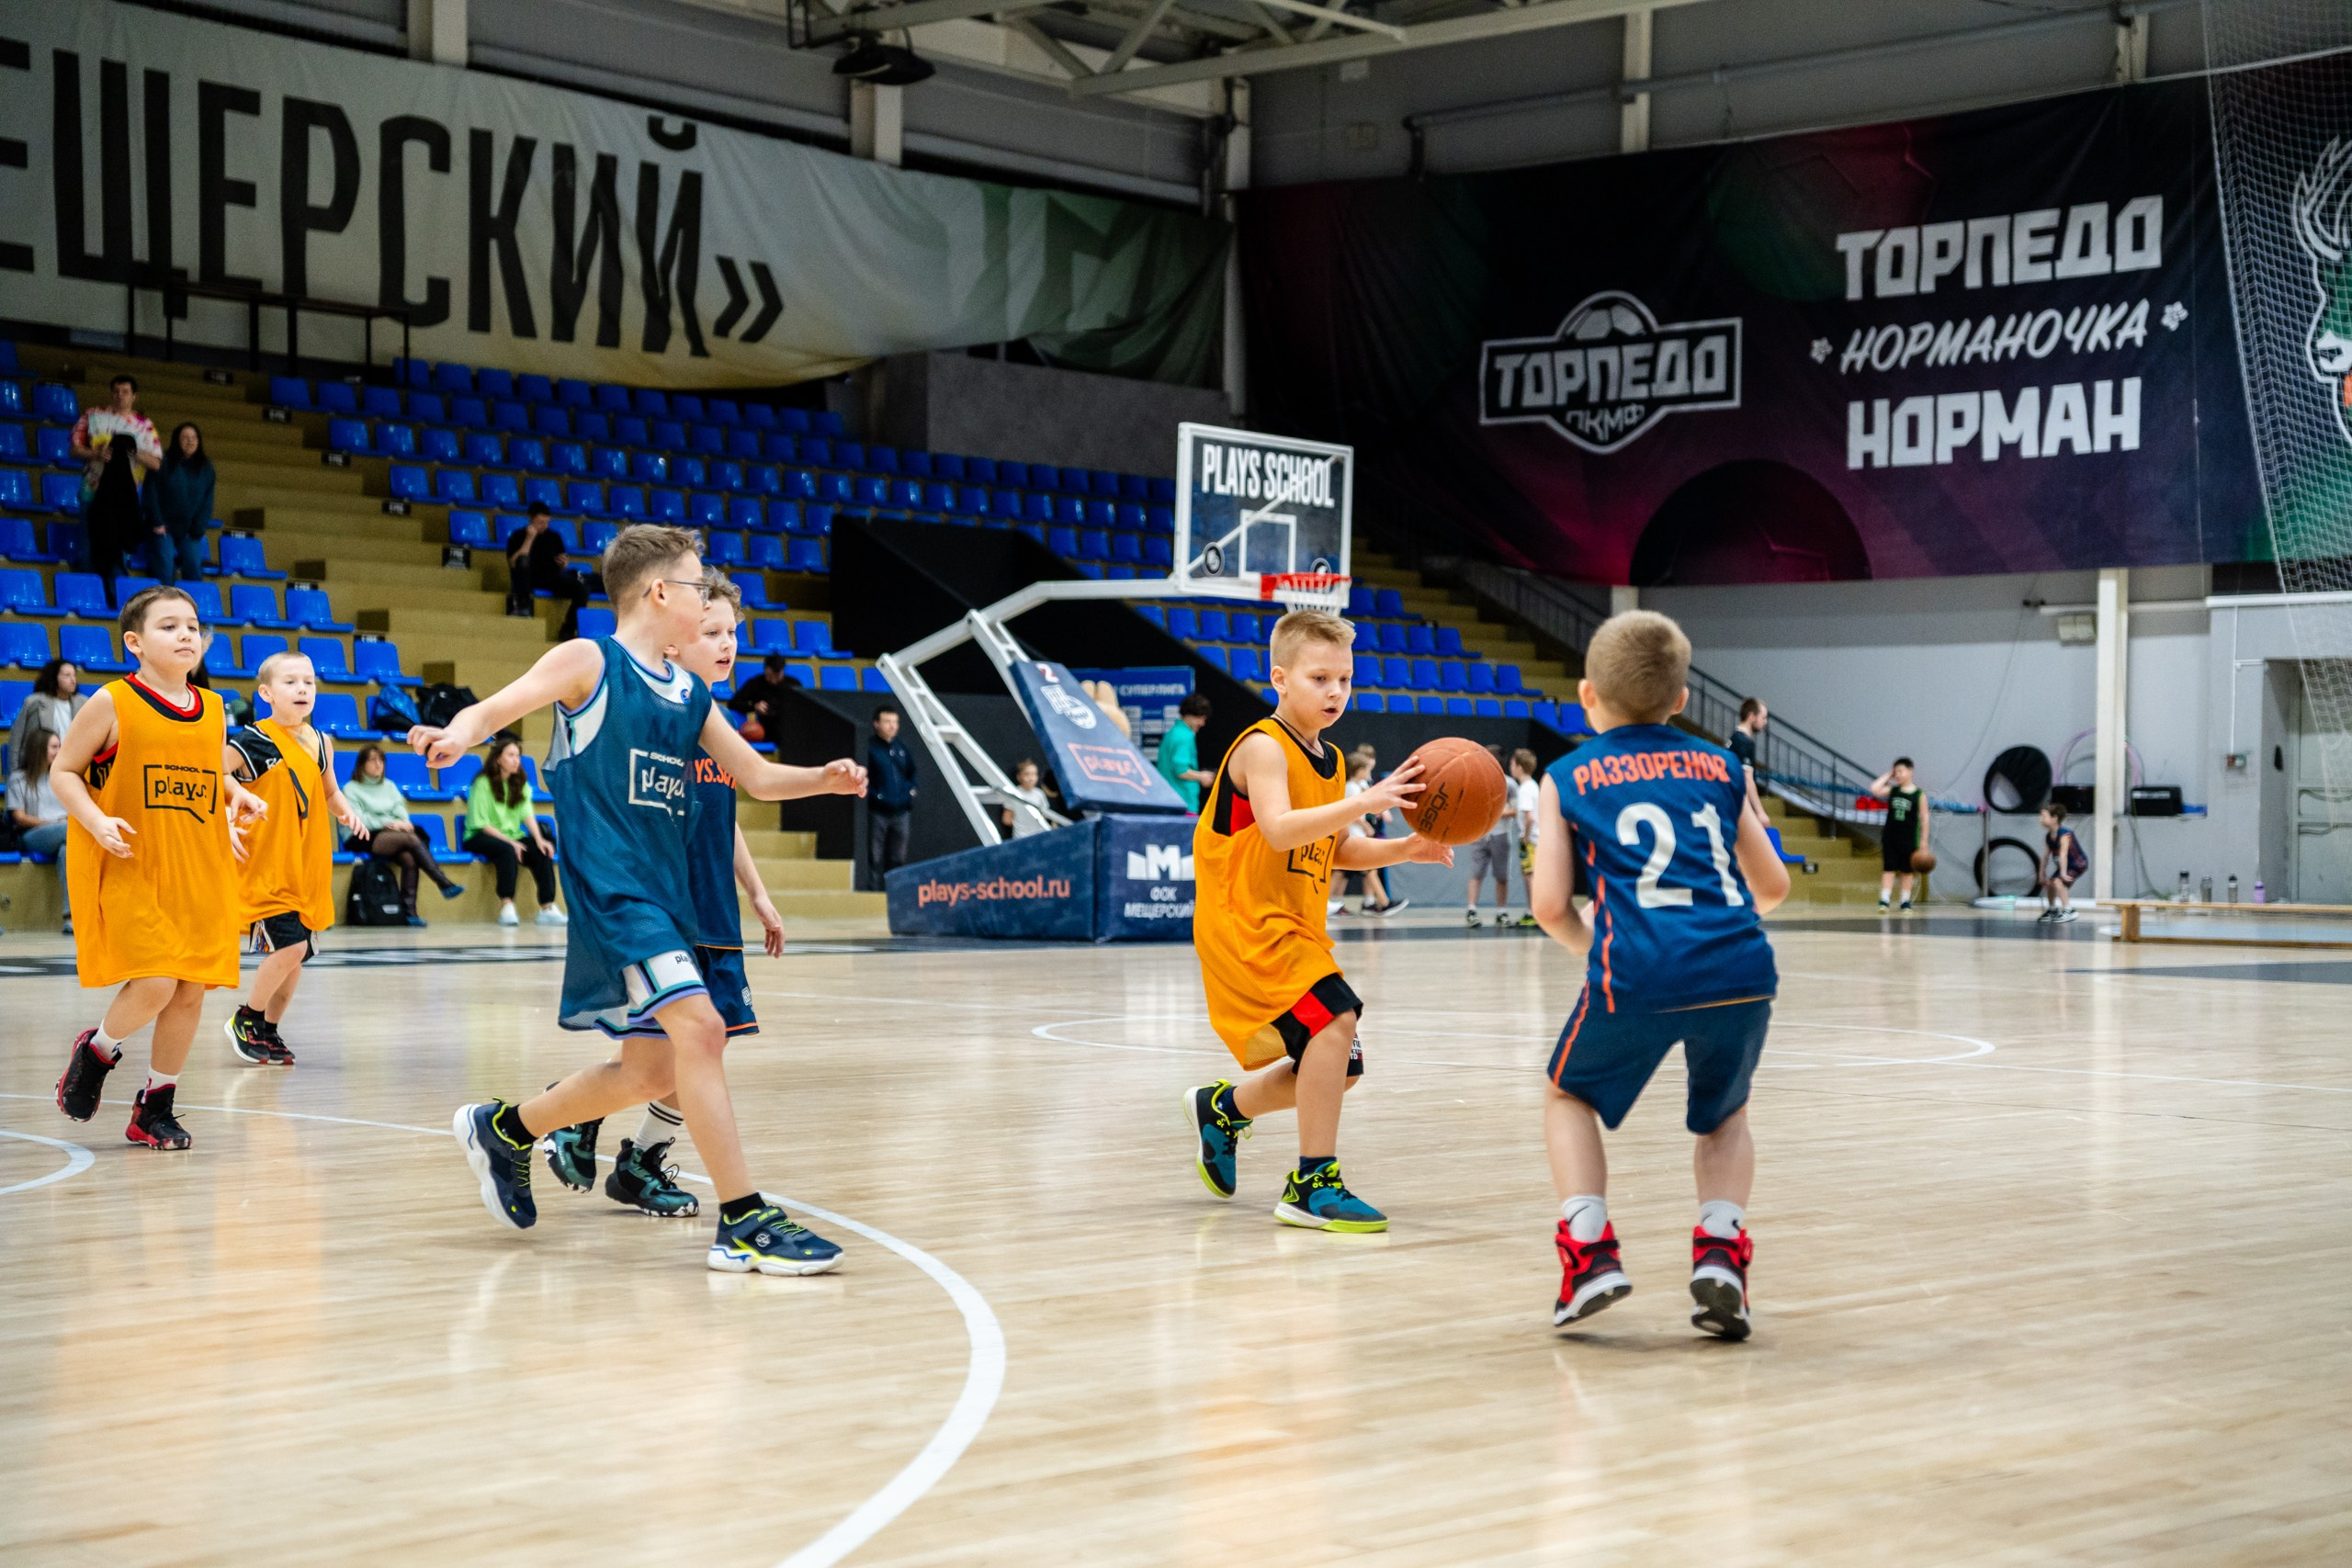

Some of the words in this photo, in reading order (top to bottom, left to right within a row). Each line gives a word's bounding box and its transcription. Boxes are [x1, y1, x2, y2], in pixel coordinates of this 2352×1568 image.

[1836, 195, 2163, 301] ТОРПЕДО
[1494, 334, 1727, 409] ТОРПЕДО
[1840, 298, 2150, 375] НОРМАНОЧКА
[1847, 376, 2143, 470] НОРМАН
[1202, 443, 1261, 500] PLAYS
[1262, 451, 1335, 508] SCHOOL
[164, 764, 200, 773] SCHOOL
[918, 874, 1070, 908] plays-school.ru
[1615, 802, 1745, 908] 21
